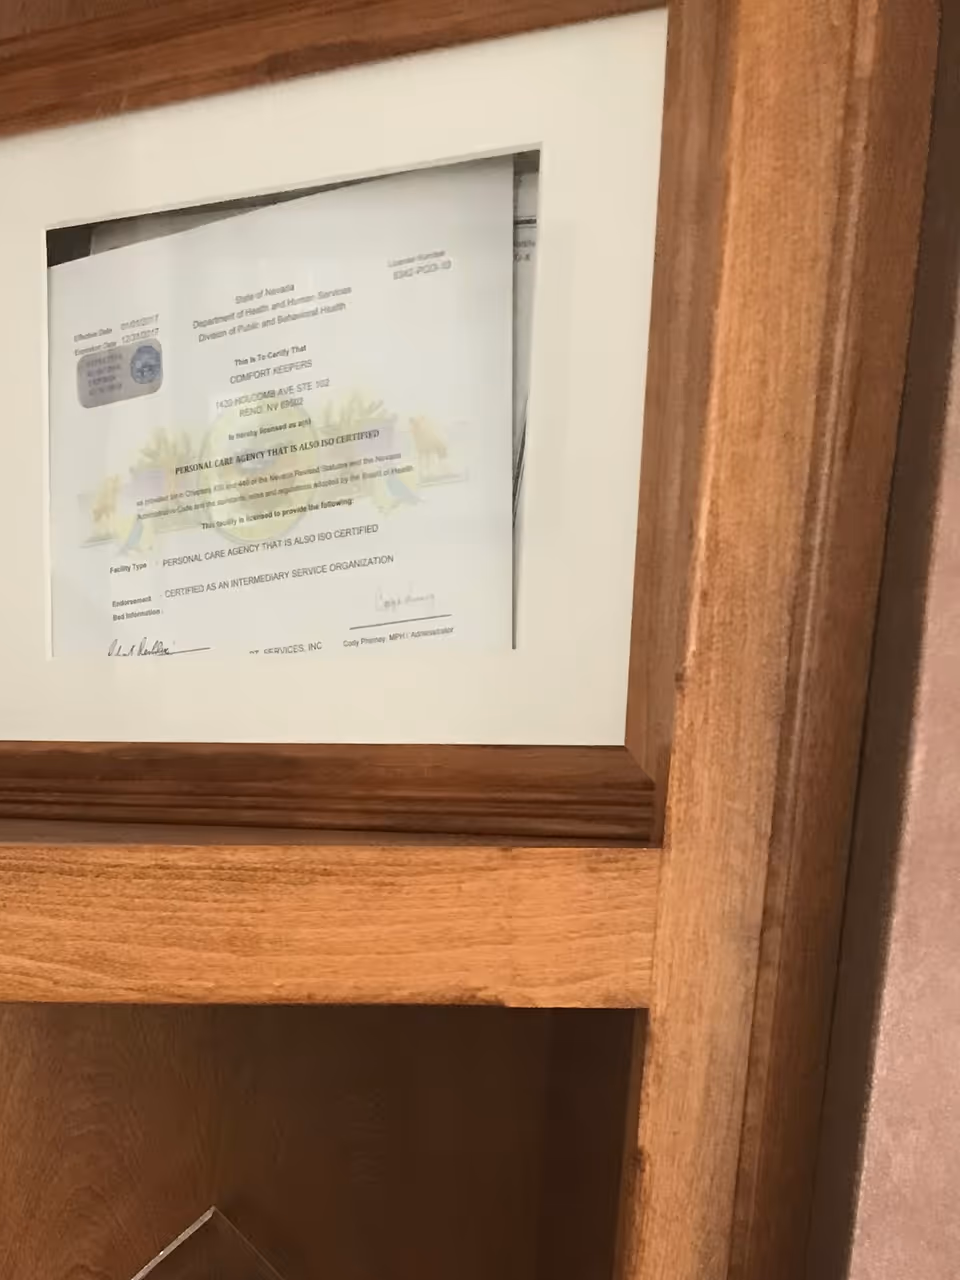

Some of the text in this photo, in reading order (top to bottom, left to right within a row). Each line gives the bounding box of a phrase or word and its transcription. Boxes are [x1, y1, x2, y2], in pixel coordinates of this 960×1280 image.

[229, 359, 313, 384] COMFORT KEEPERS
[175, 430, 380, 475] PERSONAL CARE AGENCY THAT IS ALSO ISO CERTIFIED
[162, 524, 379, 568] PERSONAL CARE AGENCY THAT IS ALSO ISO CERTIFIED
[109, 561, 147, 574] Facility Type
[165, 555, 394, 598] CERTIFIED AS AN INTERMEDIARY SERVICE ORGANIZATION
[112, 596, 152, 608] Endorsement
